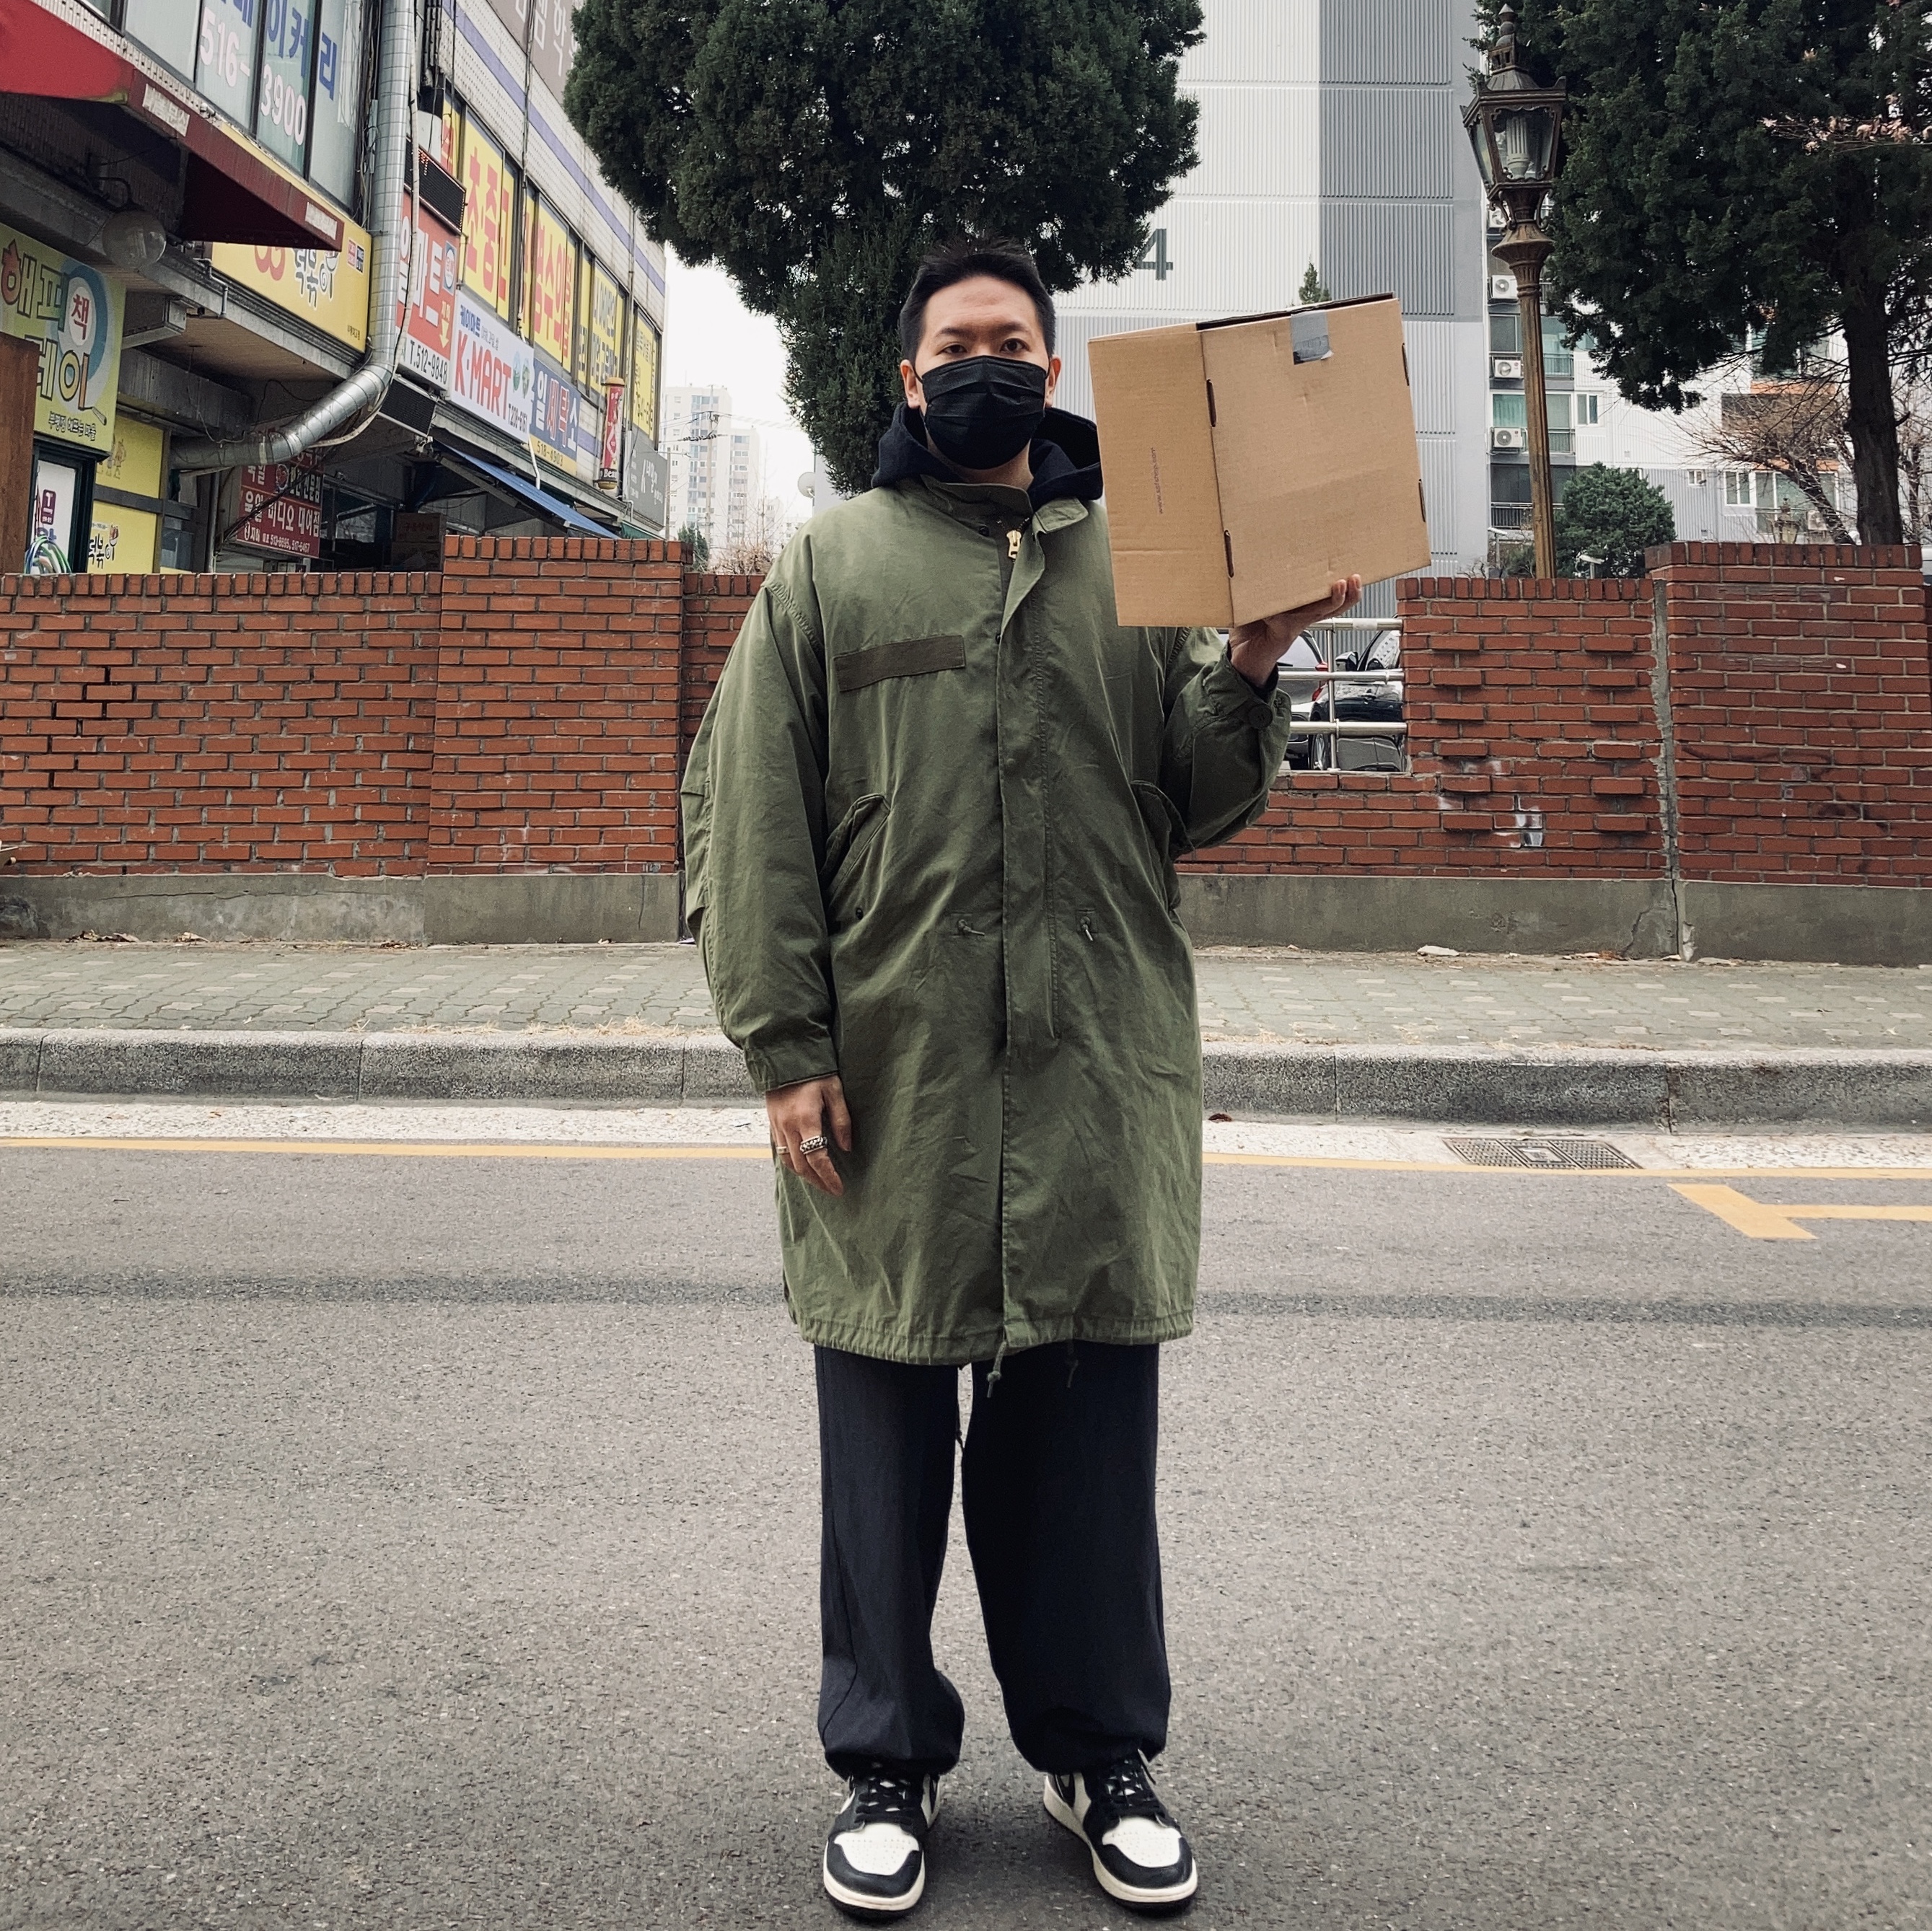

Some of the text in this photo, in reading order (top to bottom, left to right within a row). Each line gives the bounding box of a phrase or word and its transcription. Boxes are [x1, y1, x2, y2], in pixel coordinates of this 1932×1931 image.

[1, 238, 89, 340] 해피 책
[268, 500, 294, 532] 비디오
[298, 506, 320, 537] 대여점
